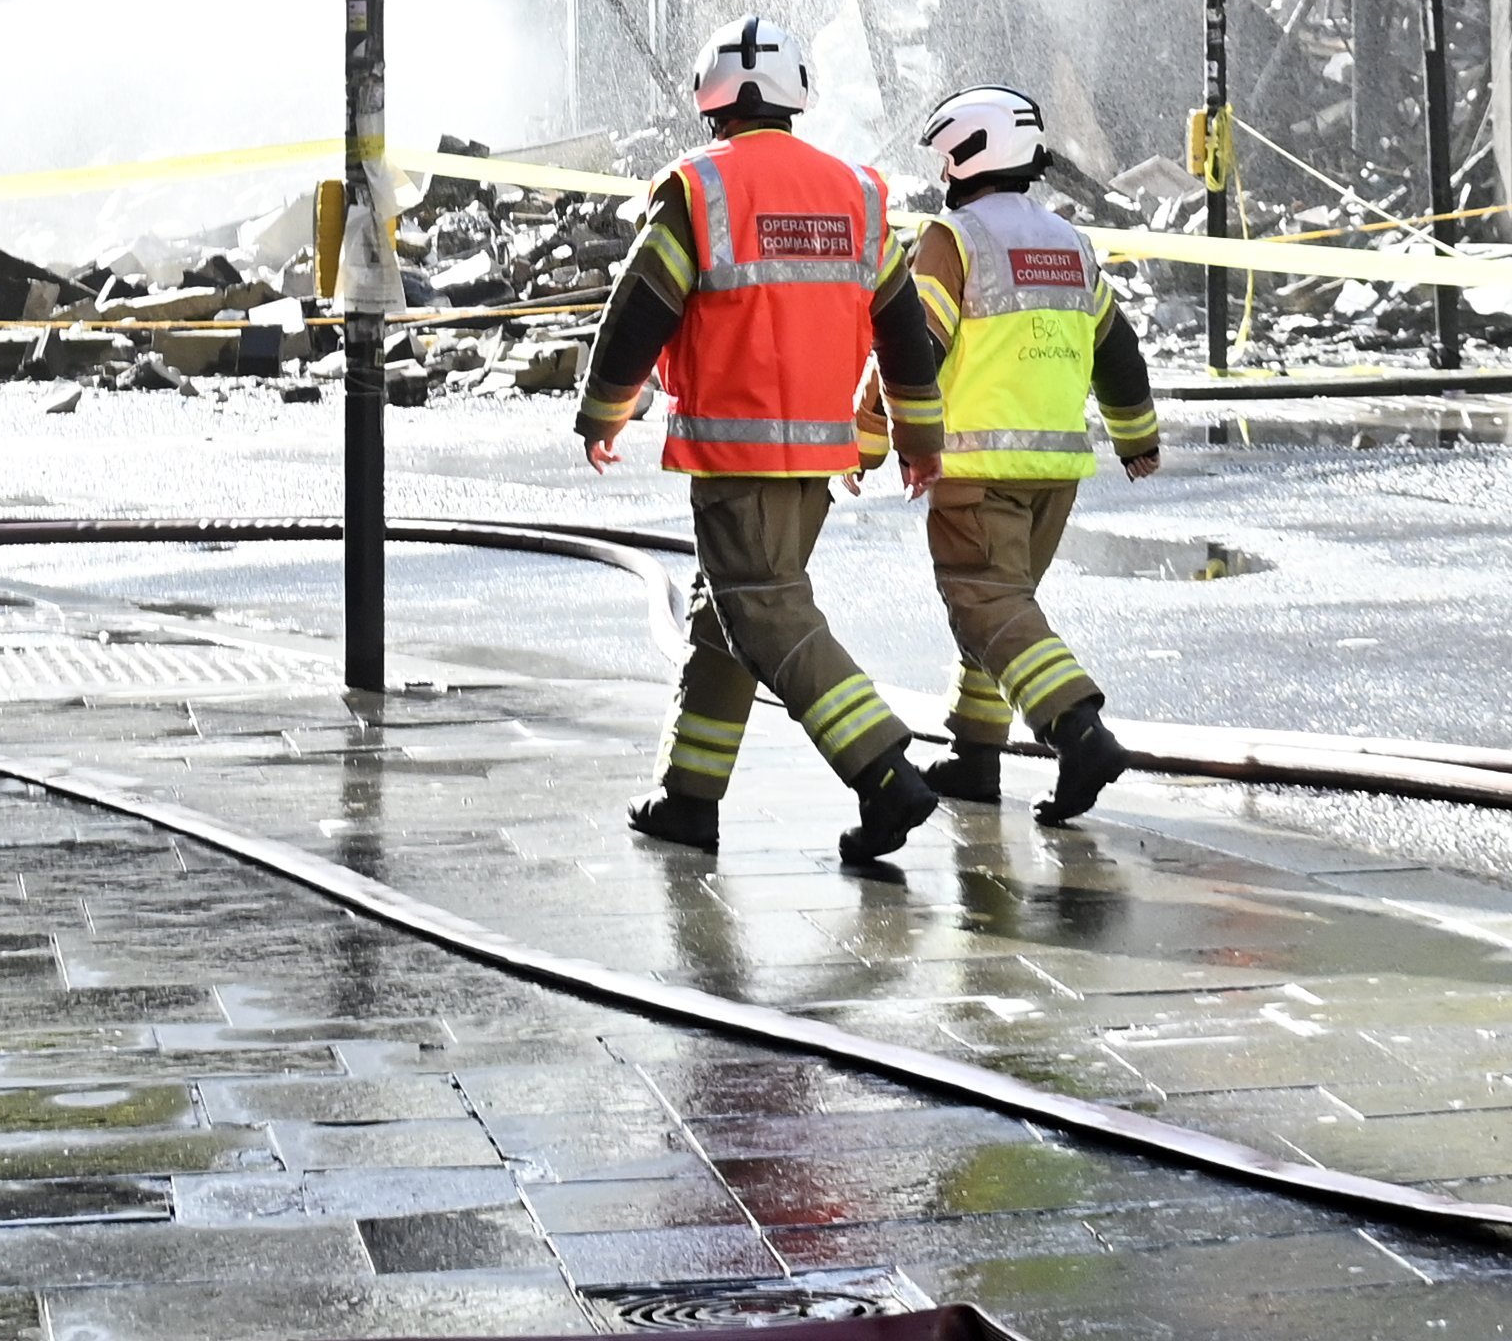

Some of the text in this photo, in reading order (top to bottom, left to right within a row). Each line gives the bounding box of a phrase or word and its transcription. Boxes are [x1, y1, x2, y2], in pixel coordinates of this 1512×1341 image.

[762, 219, 847, 234] OPERATIONS
[763, 236, 849, 252] COMMANDER
[1024, 253, 1072, 266] INCIDENT
[1016, 268, 1084, 283] COMMANDER
